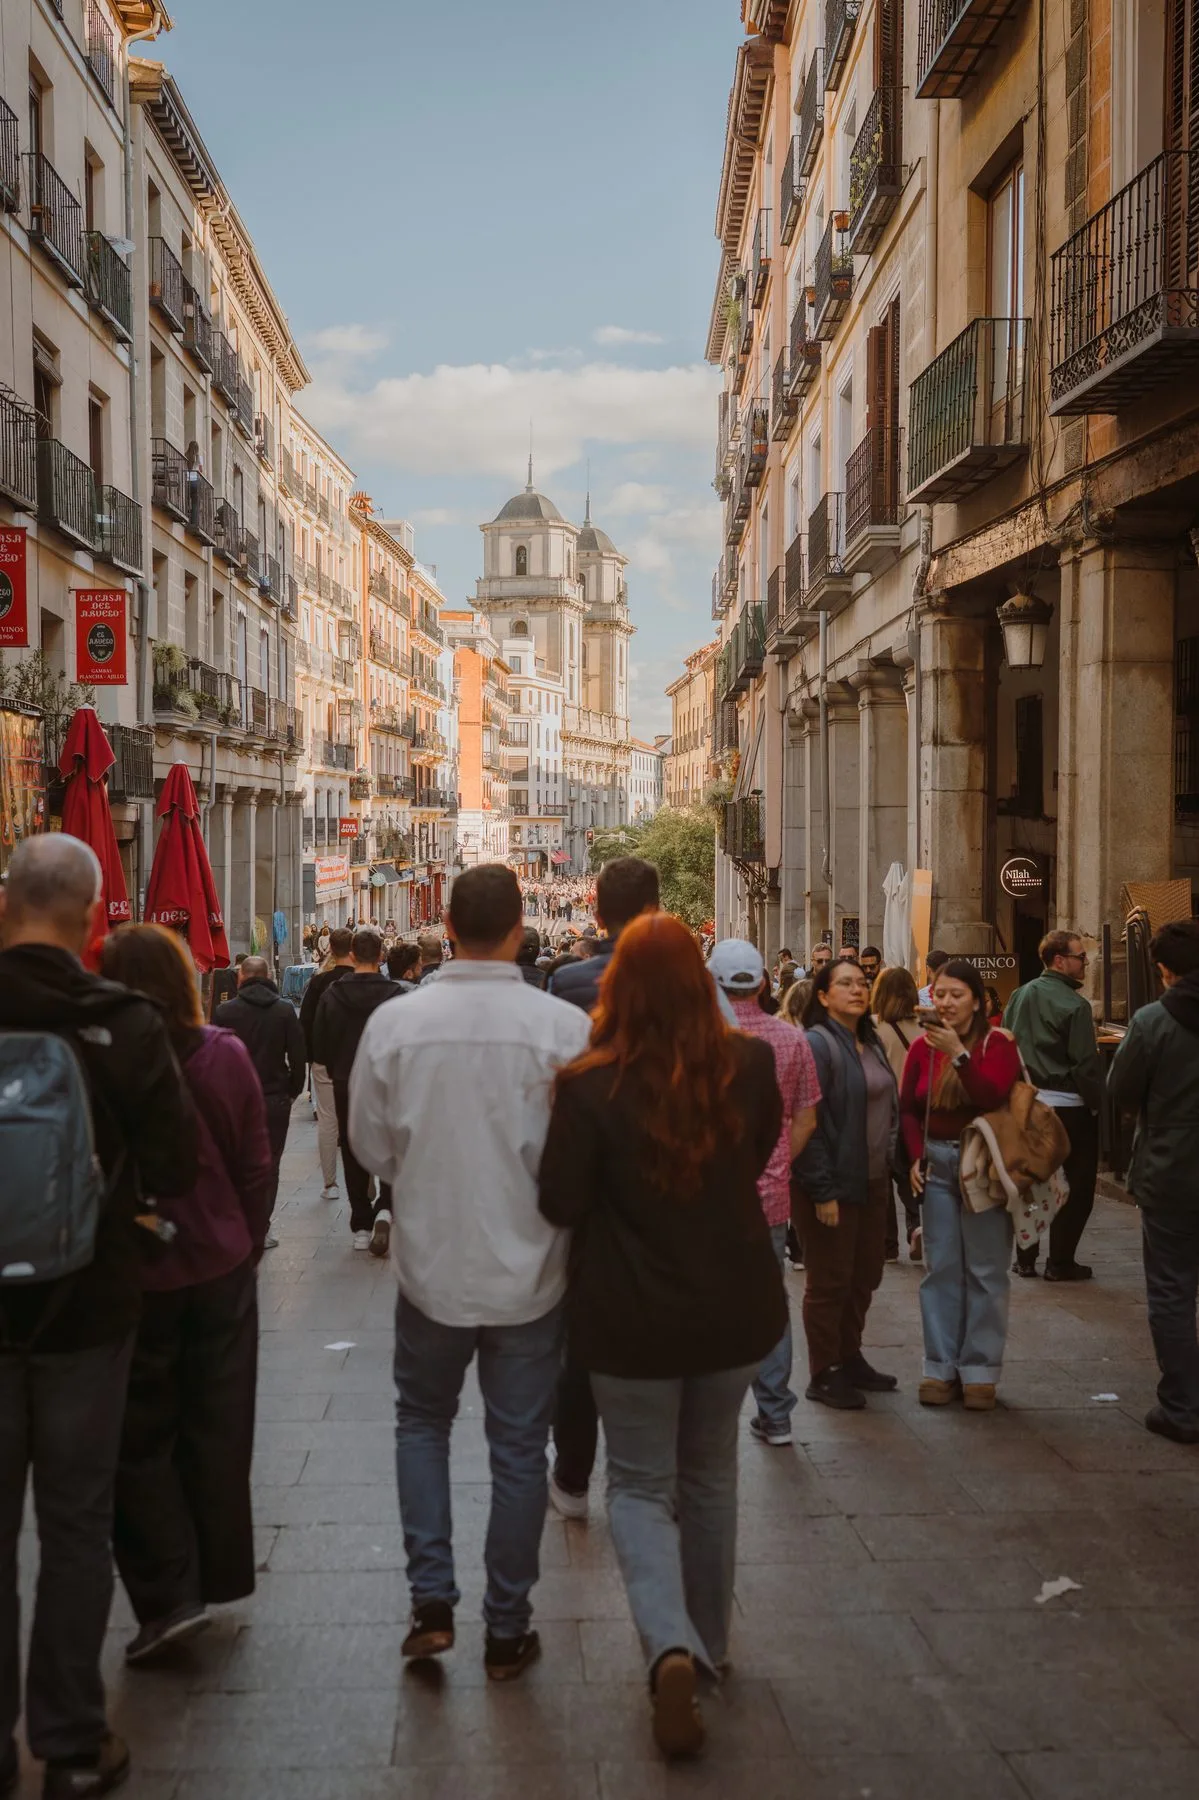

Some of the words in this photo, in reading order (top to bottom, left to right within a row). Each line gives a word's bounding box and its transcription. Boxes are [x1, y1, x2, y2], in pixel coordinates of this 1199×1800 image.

[0, 534, 21, 543] ASA
[80, 594, 93, 602] LA
[95, 594, 122, 602] CASA
[91, 602, 110, 610] DEL
[80, 610, 120, 618] ABUELO
[1005, 869, 1030, 879] Nilah
